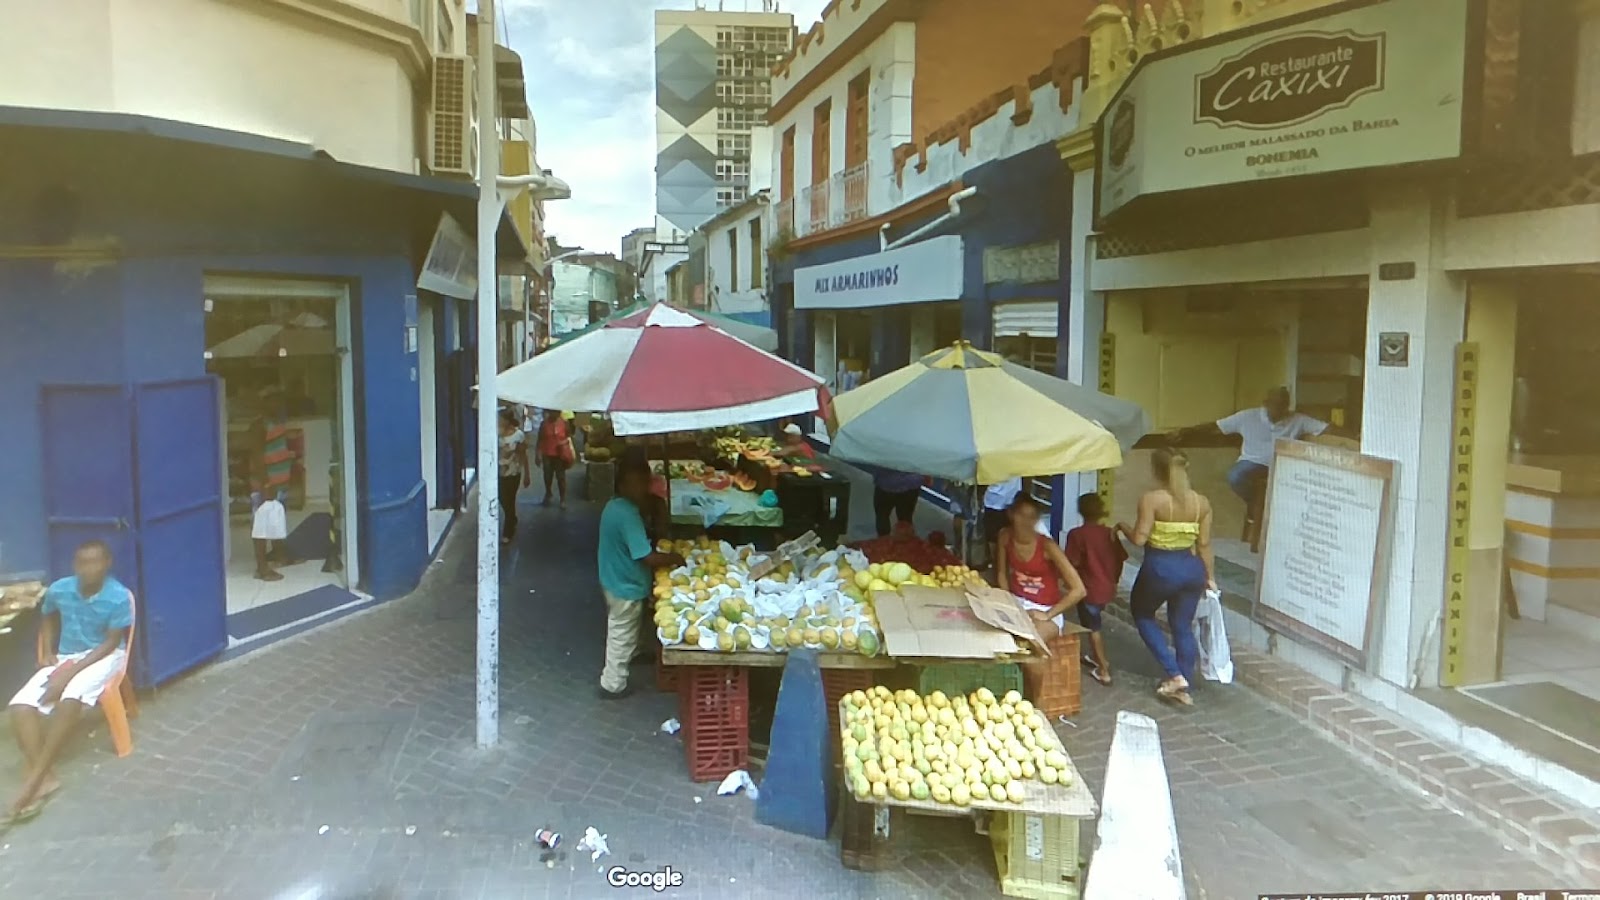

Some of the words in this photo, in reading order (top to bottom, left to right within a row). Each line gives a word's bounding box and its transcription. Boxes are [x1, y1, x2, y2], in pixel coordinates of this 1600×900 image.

[1260, 46, 1353, 77] Restaurante
[1184, 146, 1196, 157] O
[1246, 147, 1319, 167] BOHEMIA
[814, 277, 829, 294] MIX
[831, 264, 899, 292] ARMARINHOS
[1453, 351, 1474, 548] RESTAURANTE
[1448, 572, 1463, 674] CAXIXI
